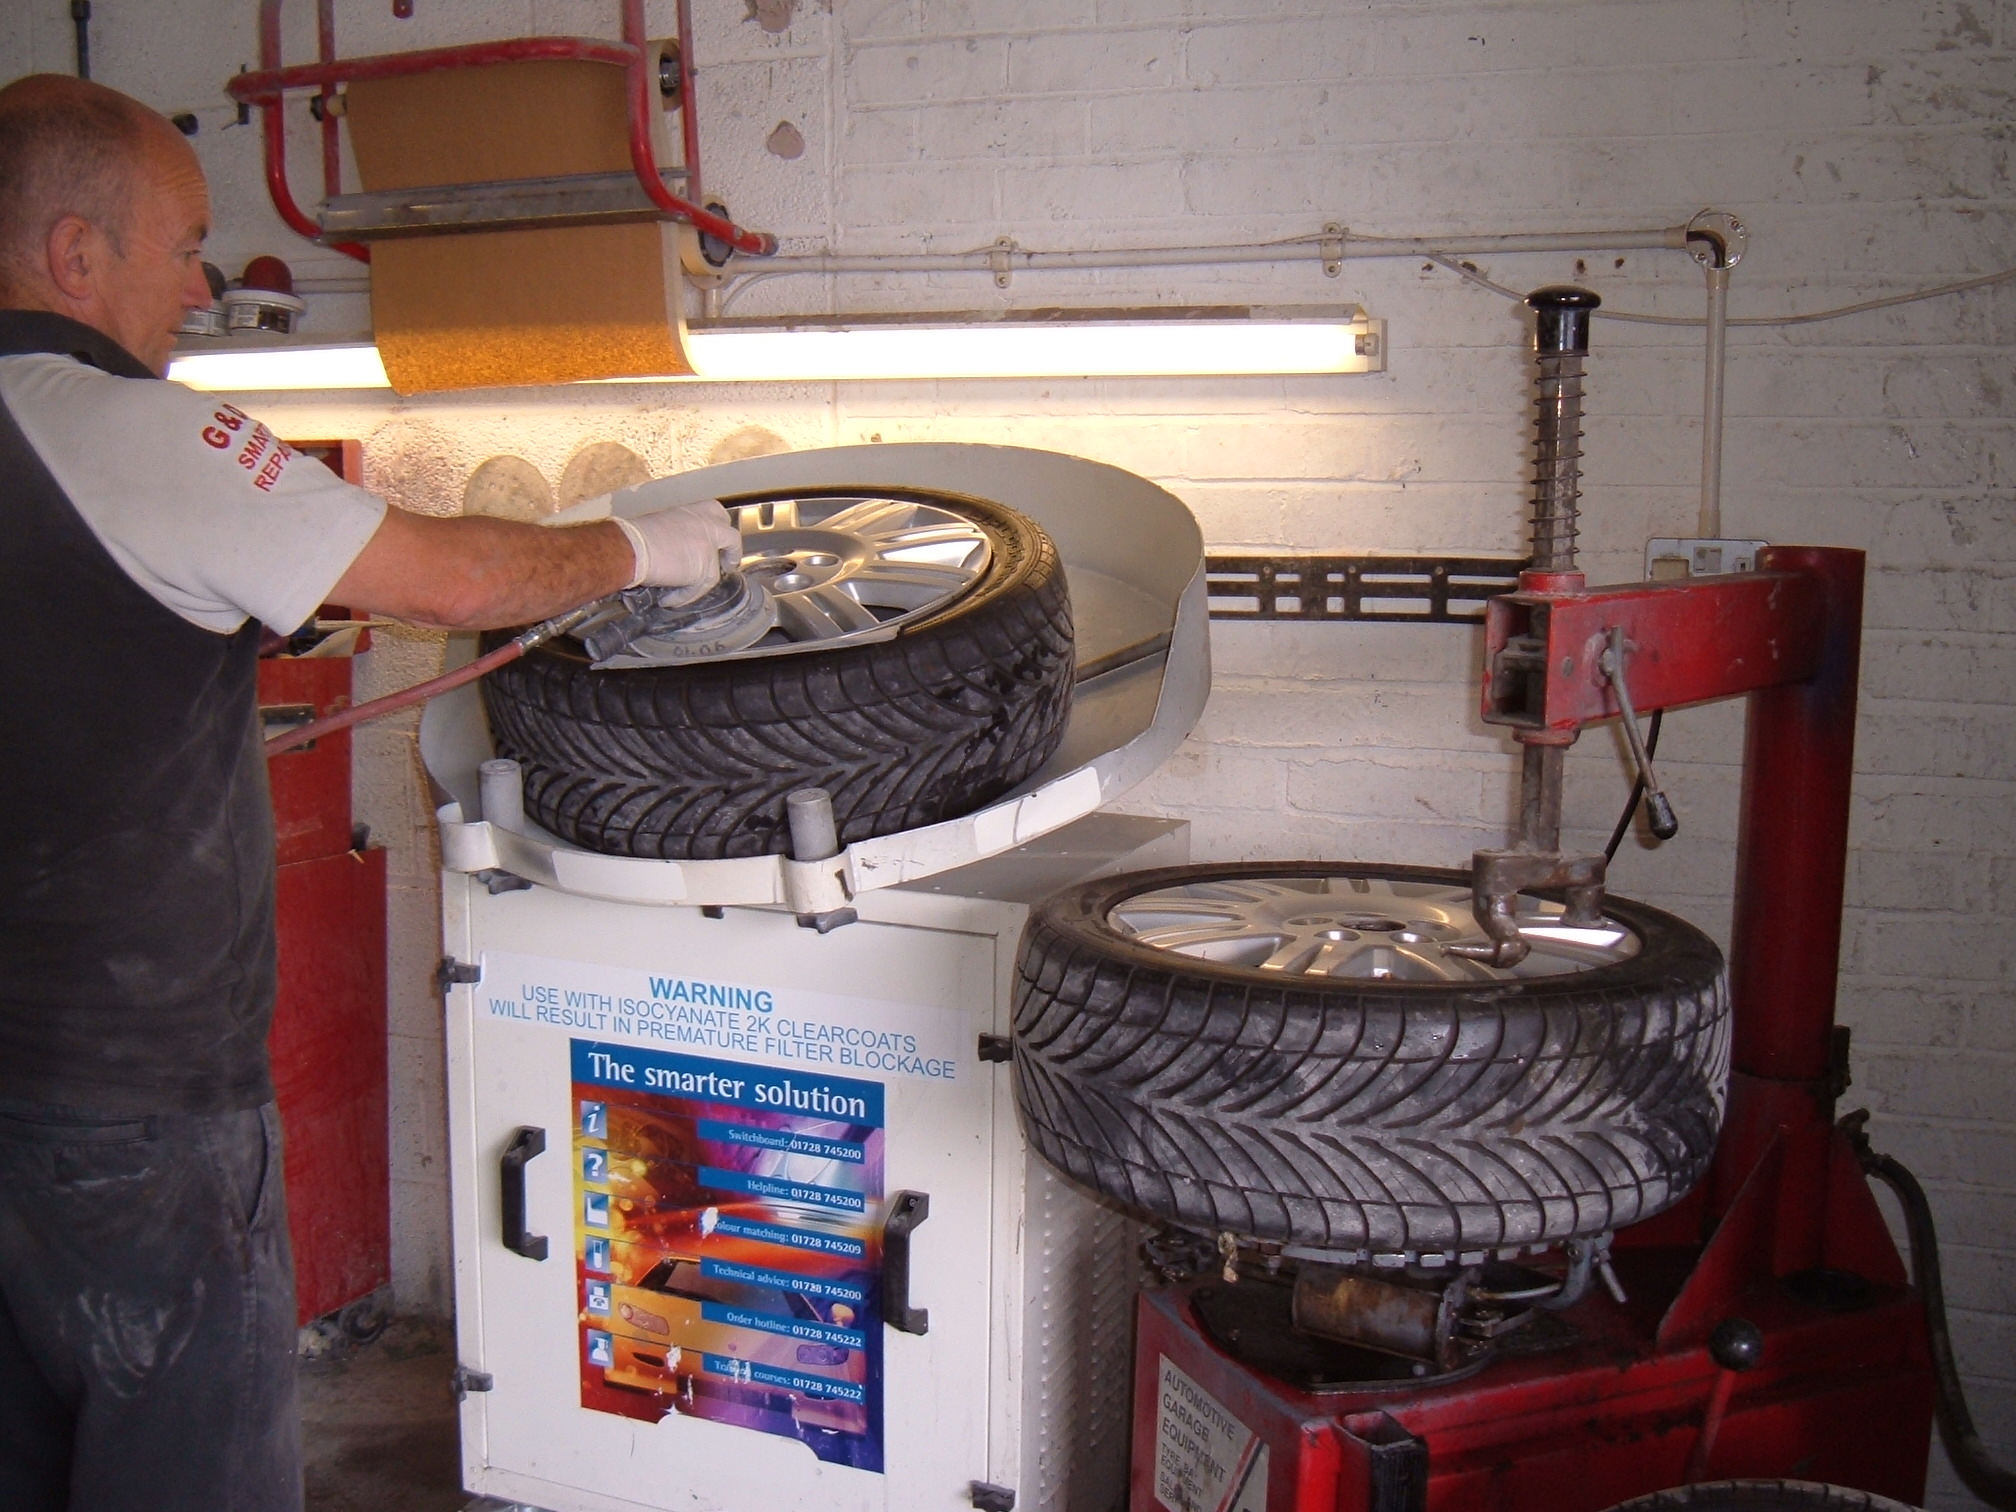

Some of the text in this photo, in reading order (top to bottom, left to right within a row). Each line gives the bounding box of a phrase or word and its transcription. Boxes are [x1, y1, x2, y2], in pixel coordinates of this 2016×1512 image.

[649, 976, 773, 1013] WARNING
[522, 984, 917, 1053] USE WITH ISOCYANATE 2K CLEARCOATS
[489, 998, 956, 1079] WILL RESULT IN PREMATURE FILTER BLOCKAGE
[588, 1052, 866, 1119] The smarter solution
[729, 1129, 862, 1160] Switchboard: 01728 745200
[747, 1180, 862, 1208] Helpline: 01728 745200
[713, 1220, 862, 1255] olour matching: 01728 745209
[713, 1264, 862, 1301] Technical advice: 01728 745200
[726, 1312, 862, 1347] Order hotline: 01728 745222
[754, 1371, 791, 1386] courses:
[792, 1378, 823, 1392] 01728
[825, 1383, 862, 1400] 745222
[1162, 1393, 1211, 1443] GARAGE
[1164, 1369, 1236, 1442] AUTOMOTIVE
